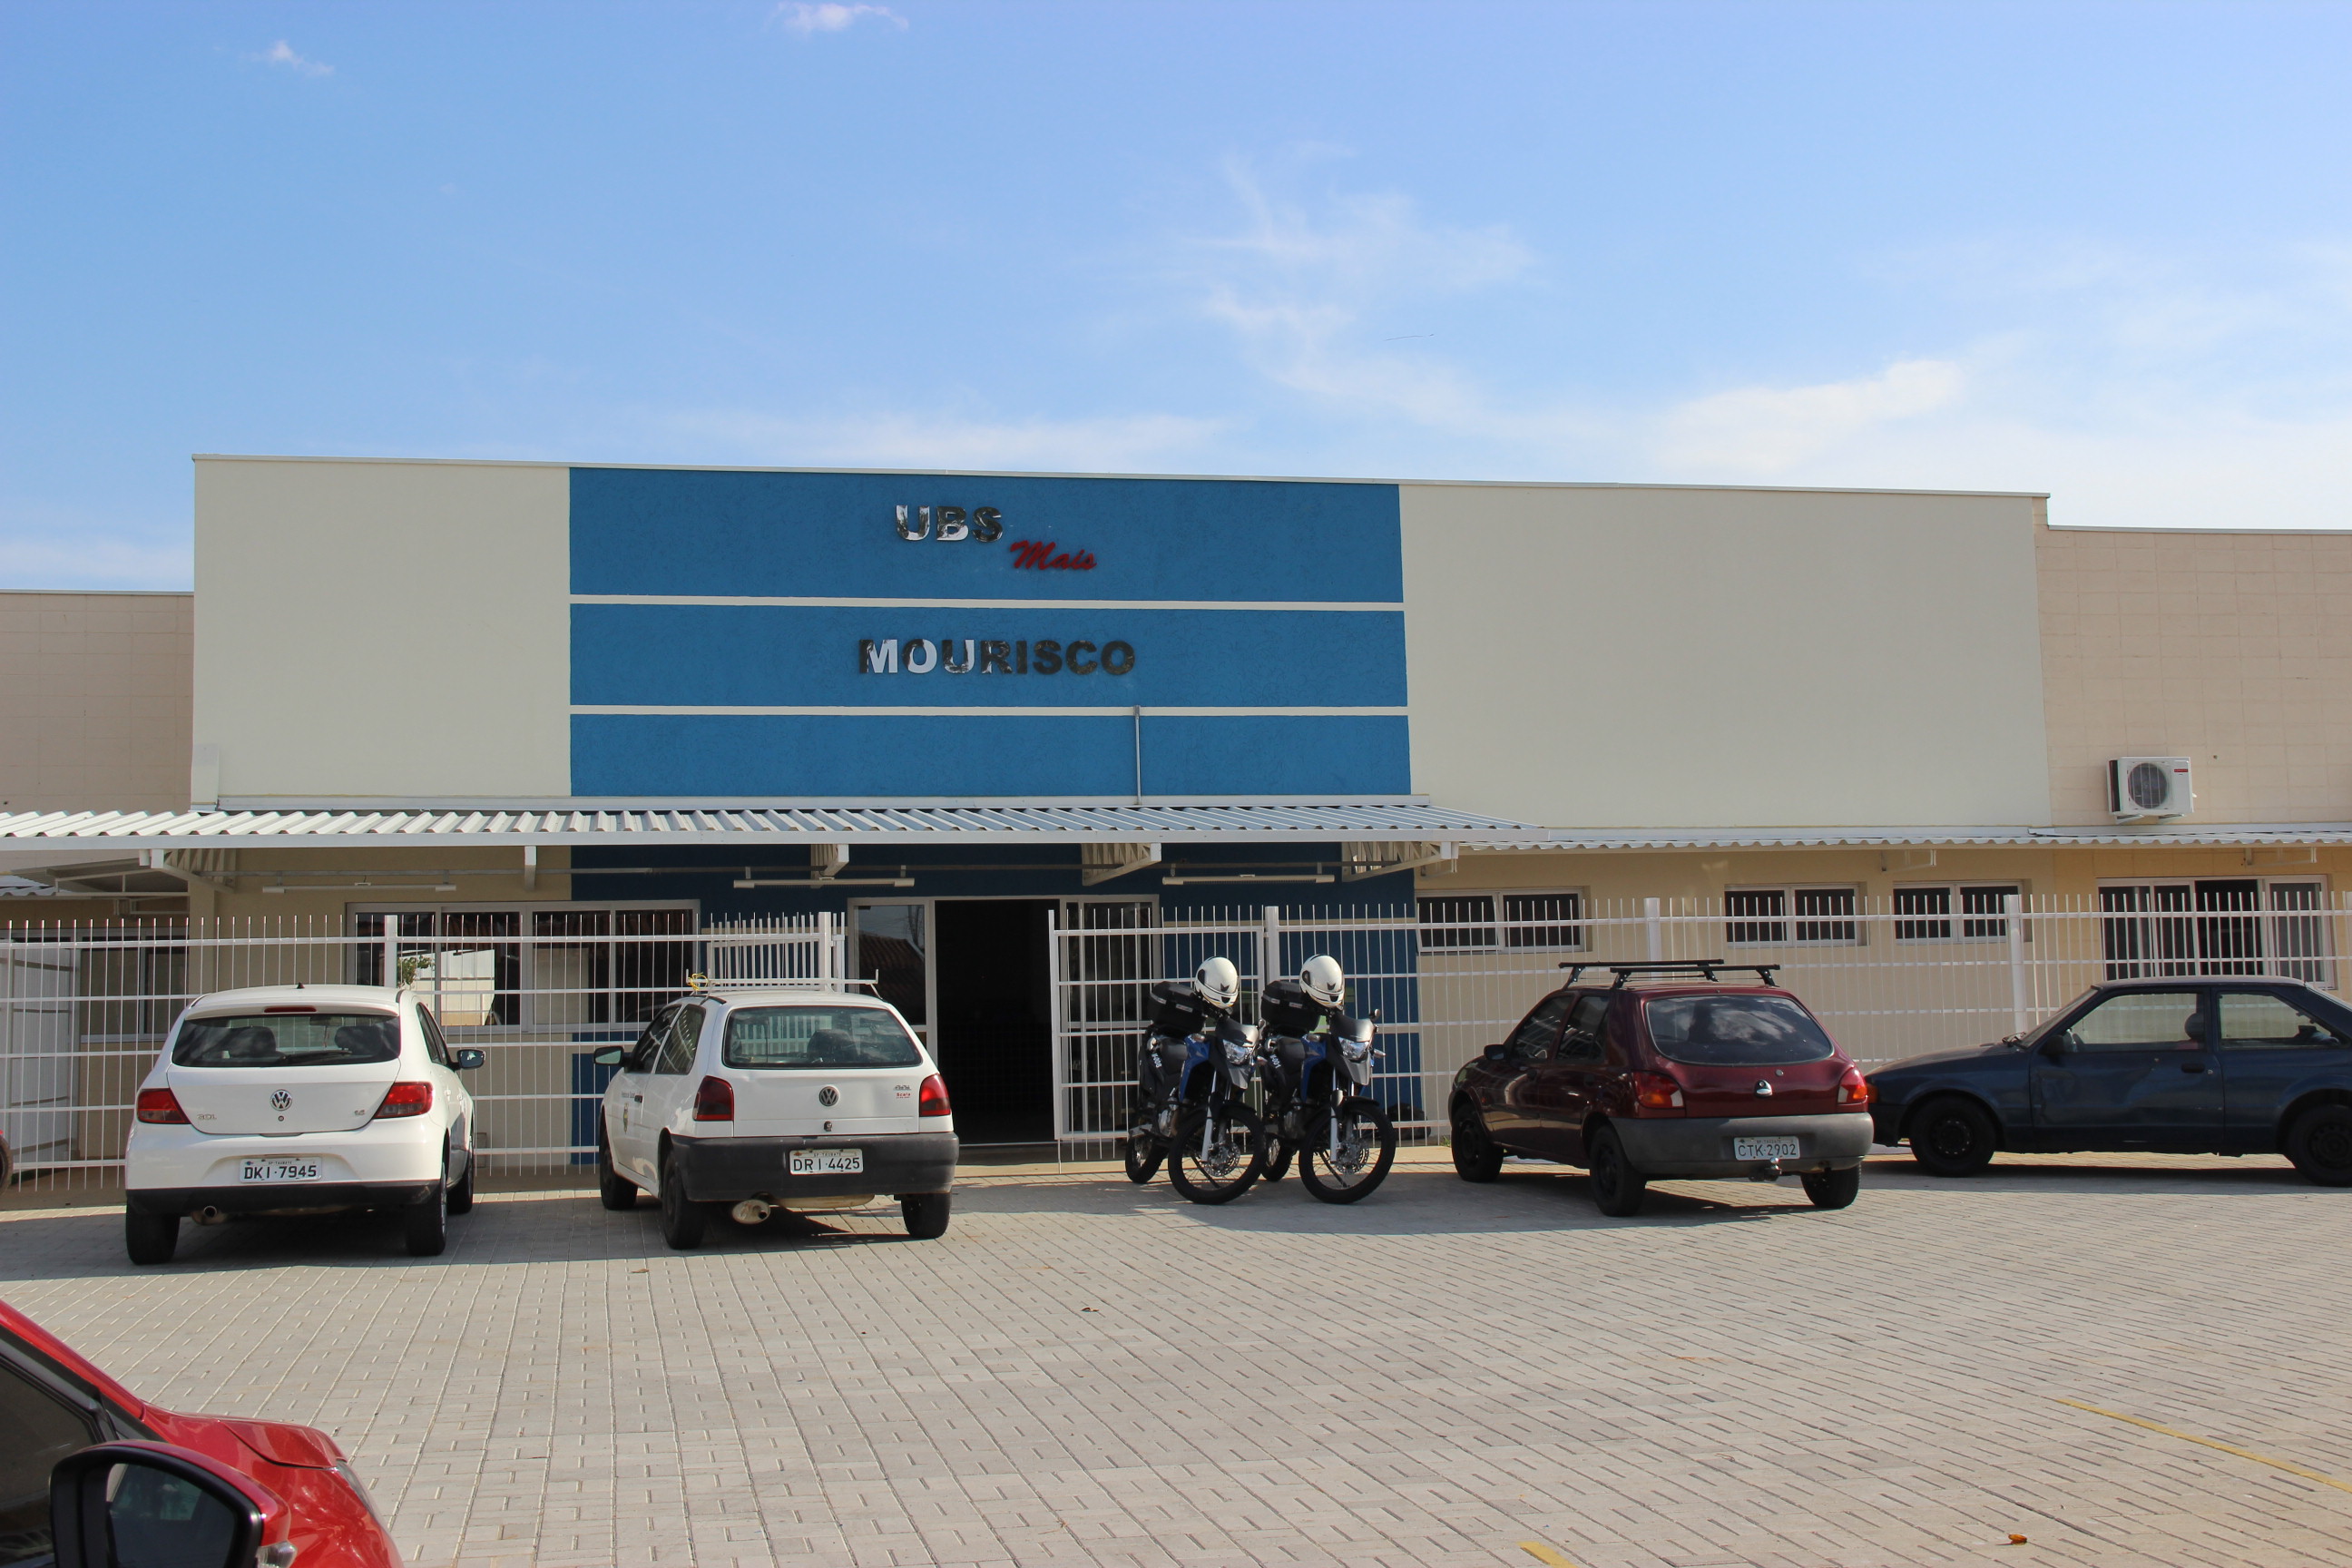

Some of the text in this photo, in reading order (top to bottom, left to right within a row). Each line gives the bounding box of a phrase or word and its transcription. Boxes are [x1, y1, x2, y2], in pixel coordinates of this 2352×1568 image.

[895, 505, 1004, 543] UBS
[1010, 540, 1098, 571] Mais
[858, 639, 1135, 676] MOURISCO
